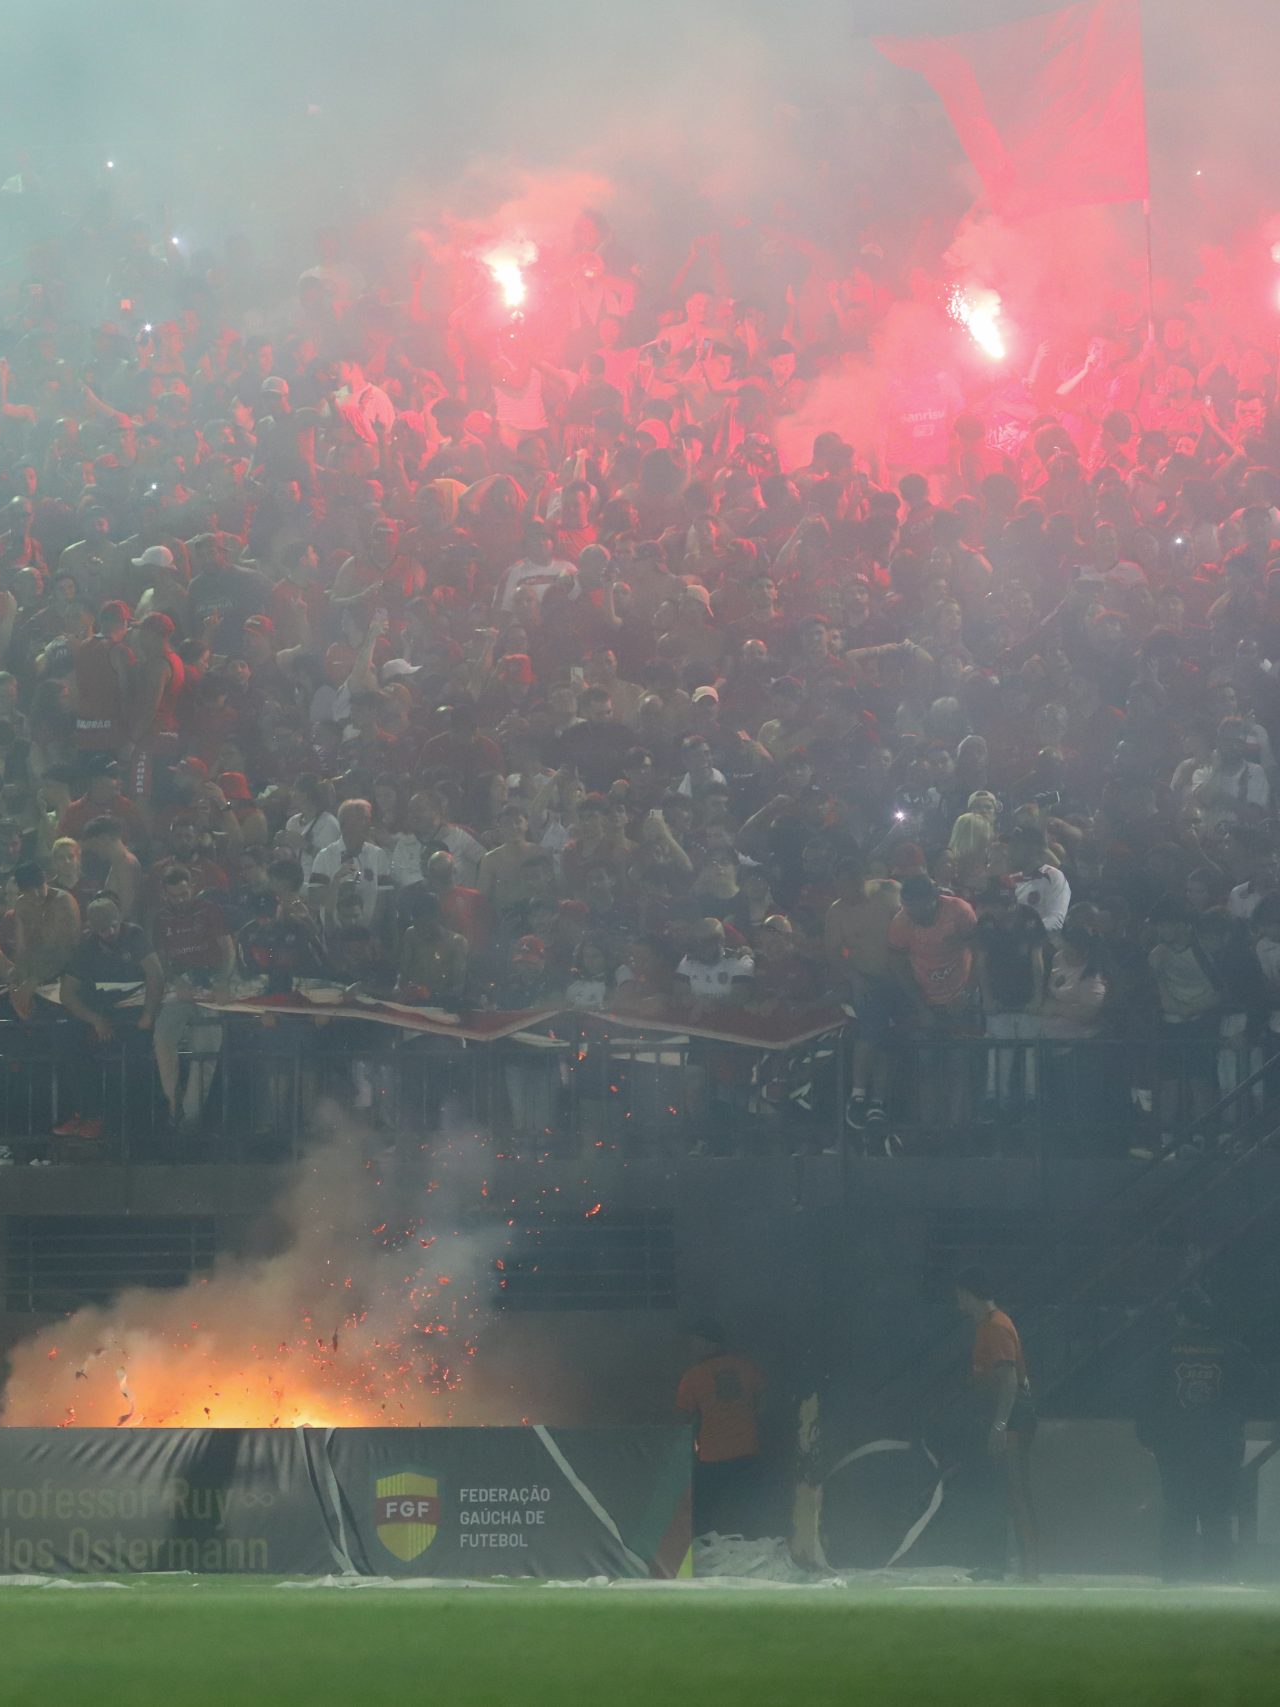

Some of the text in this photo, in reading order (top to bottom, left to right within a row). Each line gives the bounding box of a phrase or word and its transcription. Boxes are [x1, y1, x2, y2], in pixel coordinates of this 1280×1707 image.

[168, 1477, 233, 1530] Ruy
[460, 1485, 551, 1504] FEDERAÇÃO
[386, 1501, 430, 1518] FGF
[460, 1508, 546, 1525] GAÚCHA DE
[68, 1527, 268, 1569] Ostermann
[460, 1533, 529, 1548] FUTEBOL
